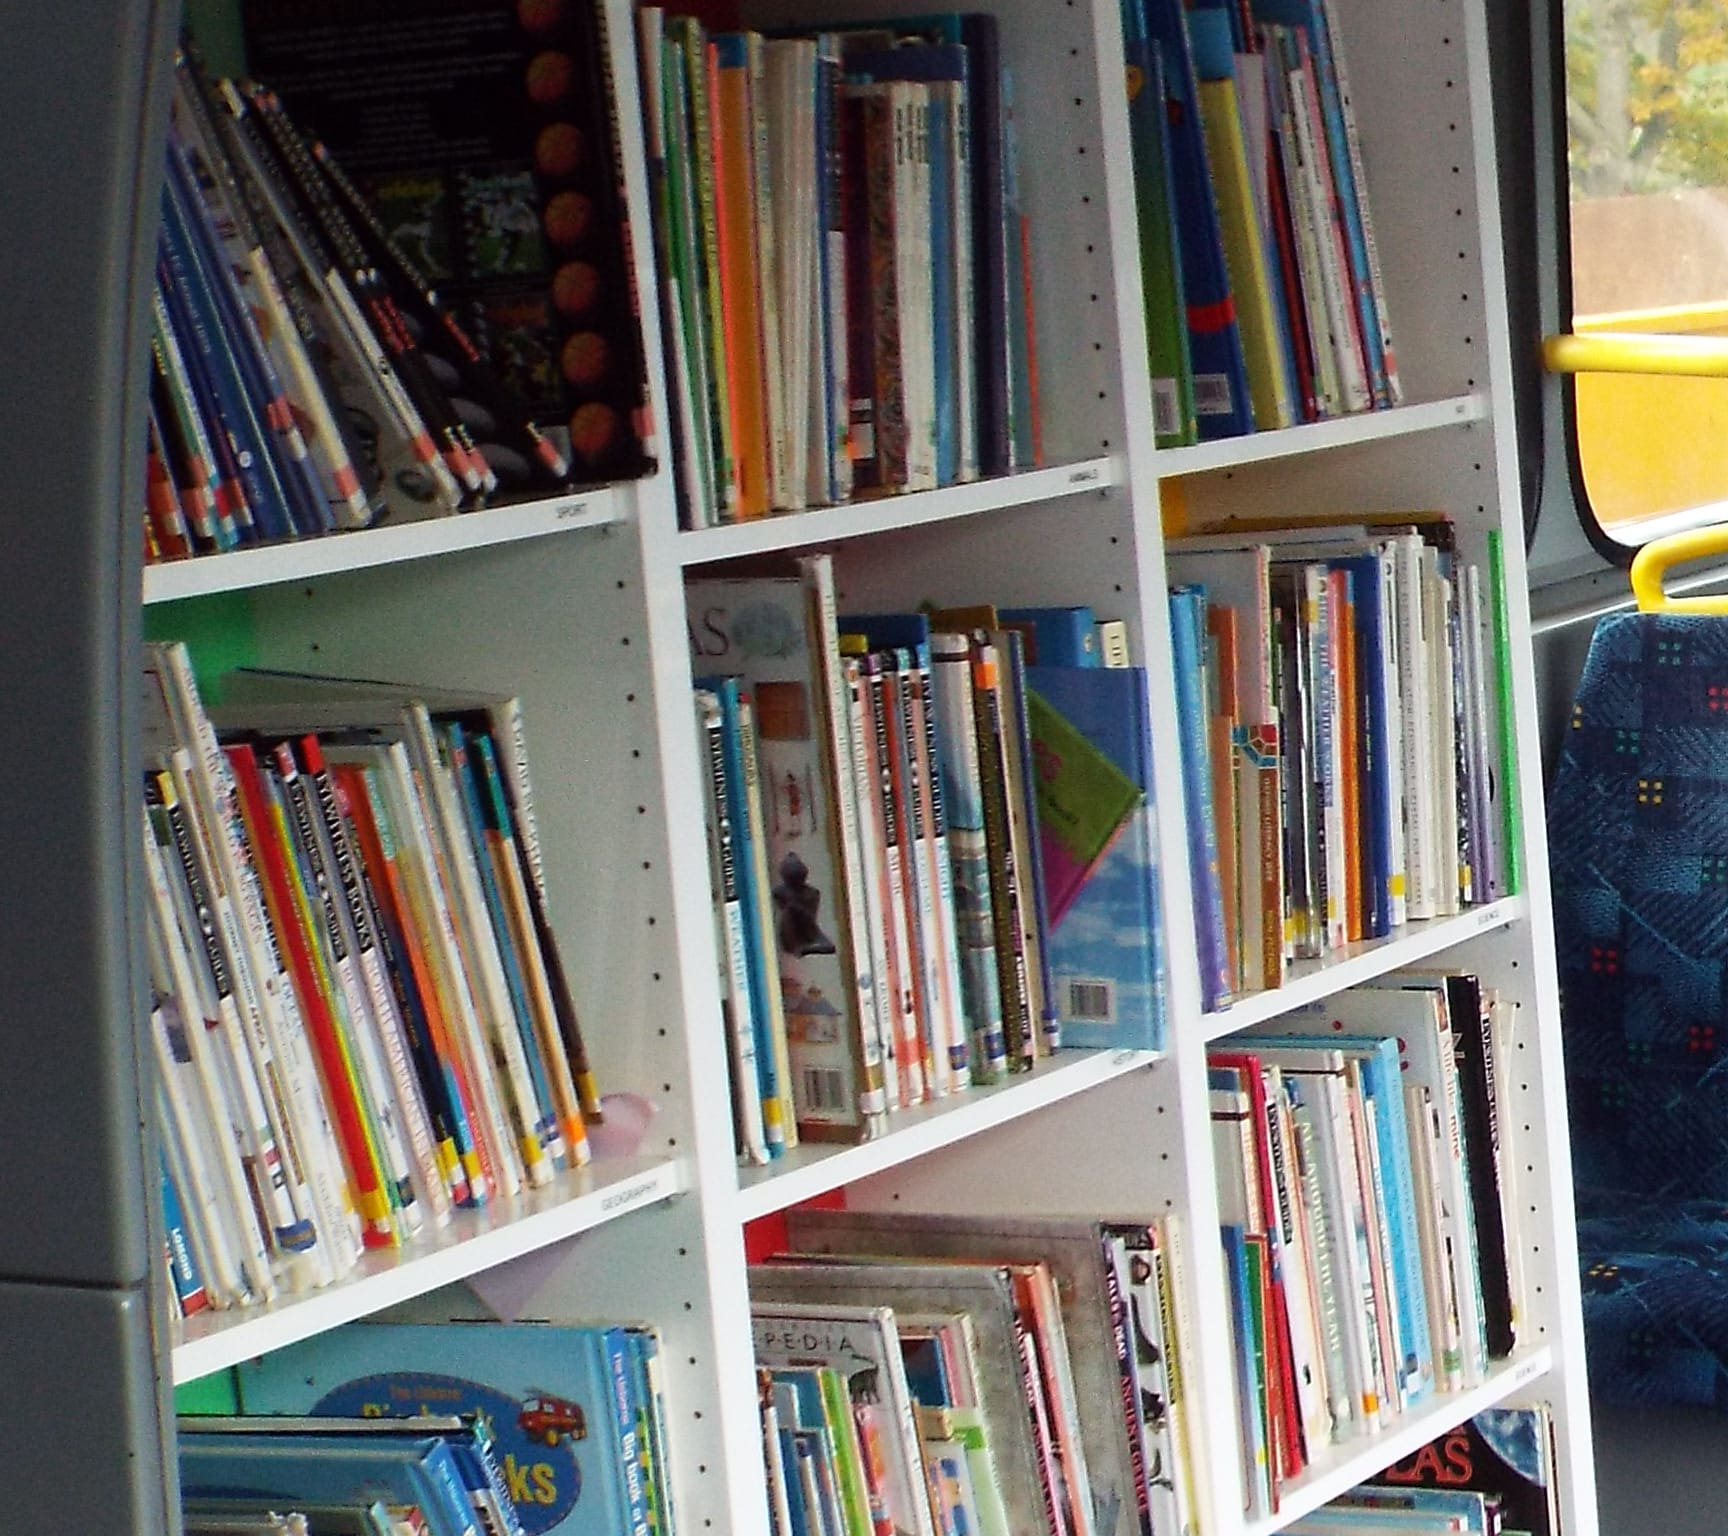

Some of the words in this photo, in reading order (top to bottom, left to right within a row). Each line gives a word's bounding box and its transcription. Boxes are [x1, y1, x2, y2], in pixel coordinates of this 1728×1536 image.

[1319, 642, 1329, 667] THE
[899, 682, 918, 759] EYEWITNESS
[919, 679, 940, 770] EYEWITNESS
[1320, 677, 1332, 747] WEATHER
[871, 685, 889, 765] EYEWITNESS
[883, 793, 898, 842] GUIDES
[1322, 751, 1333, 806] WORKS
[929, 775, 946, 834] GUIDES
[314, 772, 355, 882] EYEWITNESS
[346, 886, 374, 948] BOOKS
[708, 733, 728, 816] EYEWITNESS
[720, 845, 737, 897] GUIDES
[729, 908, 747, 991] WEATHER
[169, 809, 208, 905] EYEWITNESS
[204, 936, 230, 993] GUIDES
[1448, 1114, 1461, 1159] mine
[599, 1176, 658, 1211] GEOGRAPHY
[1305, 1161, 1328, 1247] AROUND
[171, 1227, 194, 1281] LOMOND
[1317, 1253, 1333, 1290] THE
[1105, 1270, 1120, 1311] TALES
[1113, 1325, 1127, 1360] DEAD
[1322, 1295, 1342, 1351] YEAR
[619, 1432, 638, 1461] Big
[625, 1463, 643, 1503] book
